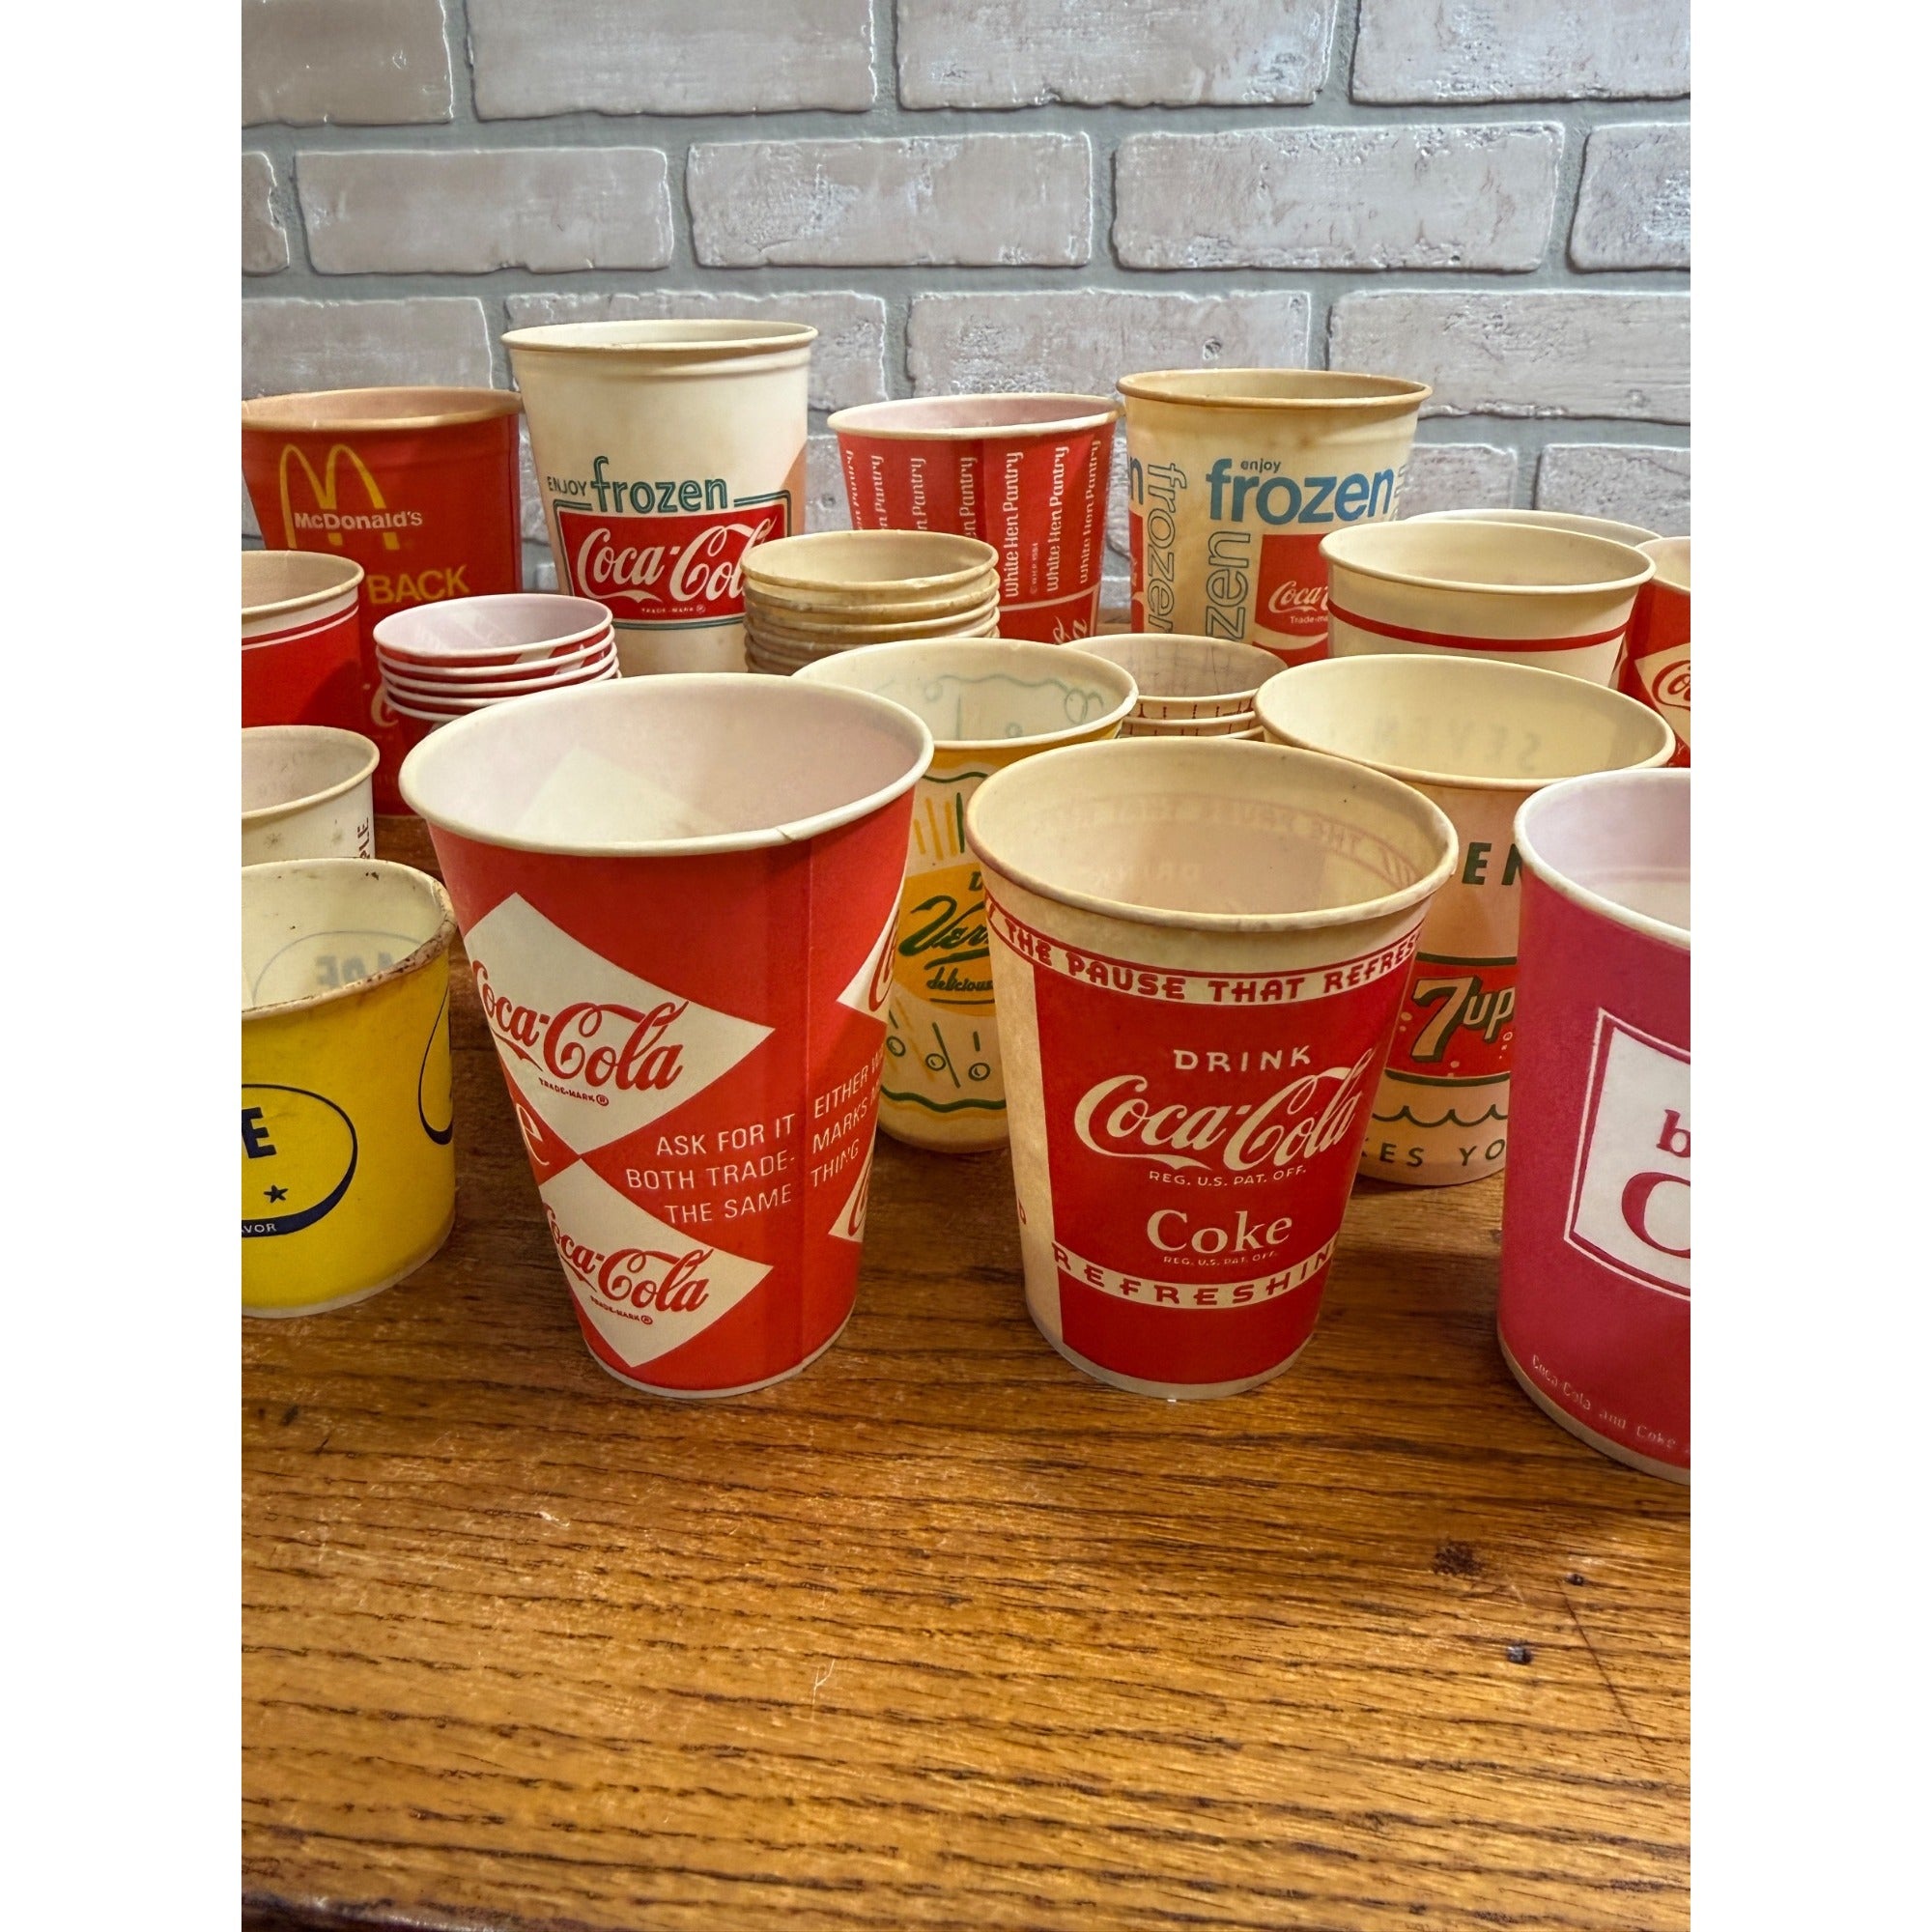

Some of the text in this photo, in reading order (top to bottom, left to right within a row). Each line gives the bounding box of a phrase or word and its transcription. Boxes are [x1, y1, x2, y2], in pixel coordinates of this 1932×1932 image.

[547, 455, 728, 514] ENJOY frozen
[910, 457, 926, 517] Pantry
[959, 456, 979, 517] Pantry
[1206, 458, 1395, 526] frozen
[1240, 458, 1281, 473] enjoy
[294, 511, 423, 530] McDonald's
[1003, 451, 1024, 598] White Hen Pantry
[1046, 446, 1069, 592] White Hen Pantry
[366, 564, 470, 606] BACK
[577, 515, 778, 603] Coca-Col
[1206, 530, 1251, 642] zen
[1005, 917, 1053, 967] THE
[1065, 951, 1186, 1001] PAUSE
[1208, 977, 1306, 1003] THAT
[1174, 1045, 1311, 1072] DRINK
[656, 1133, 707, 1156] ASK
[718, 1123, 764, 1152] FOR
[776, 1113, 795, 1139] IT
[813, 1065, 869, 1119] EITHER
[1074, 1047, 1376, 1171] Coca-Cola
[626, 1096, 868, 1190] BOTH TRADE- MARKS
[1459, 1138, 1505, 1166] YO
[664, 1138, 860, 1224] THE SAME THING
[1149, 1165, 1307, 1187] REG. U.S. PAT. OFF.
[1147, 1208, 1293, 1254] Coke
[1163, 1256, 1194, 1266] REG.
[1051, 1240, 1331, 1306] REFRESHIN
